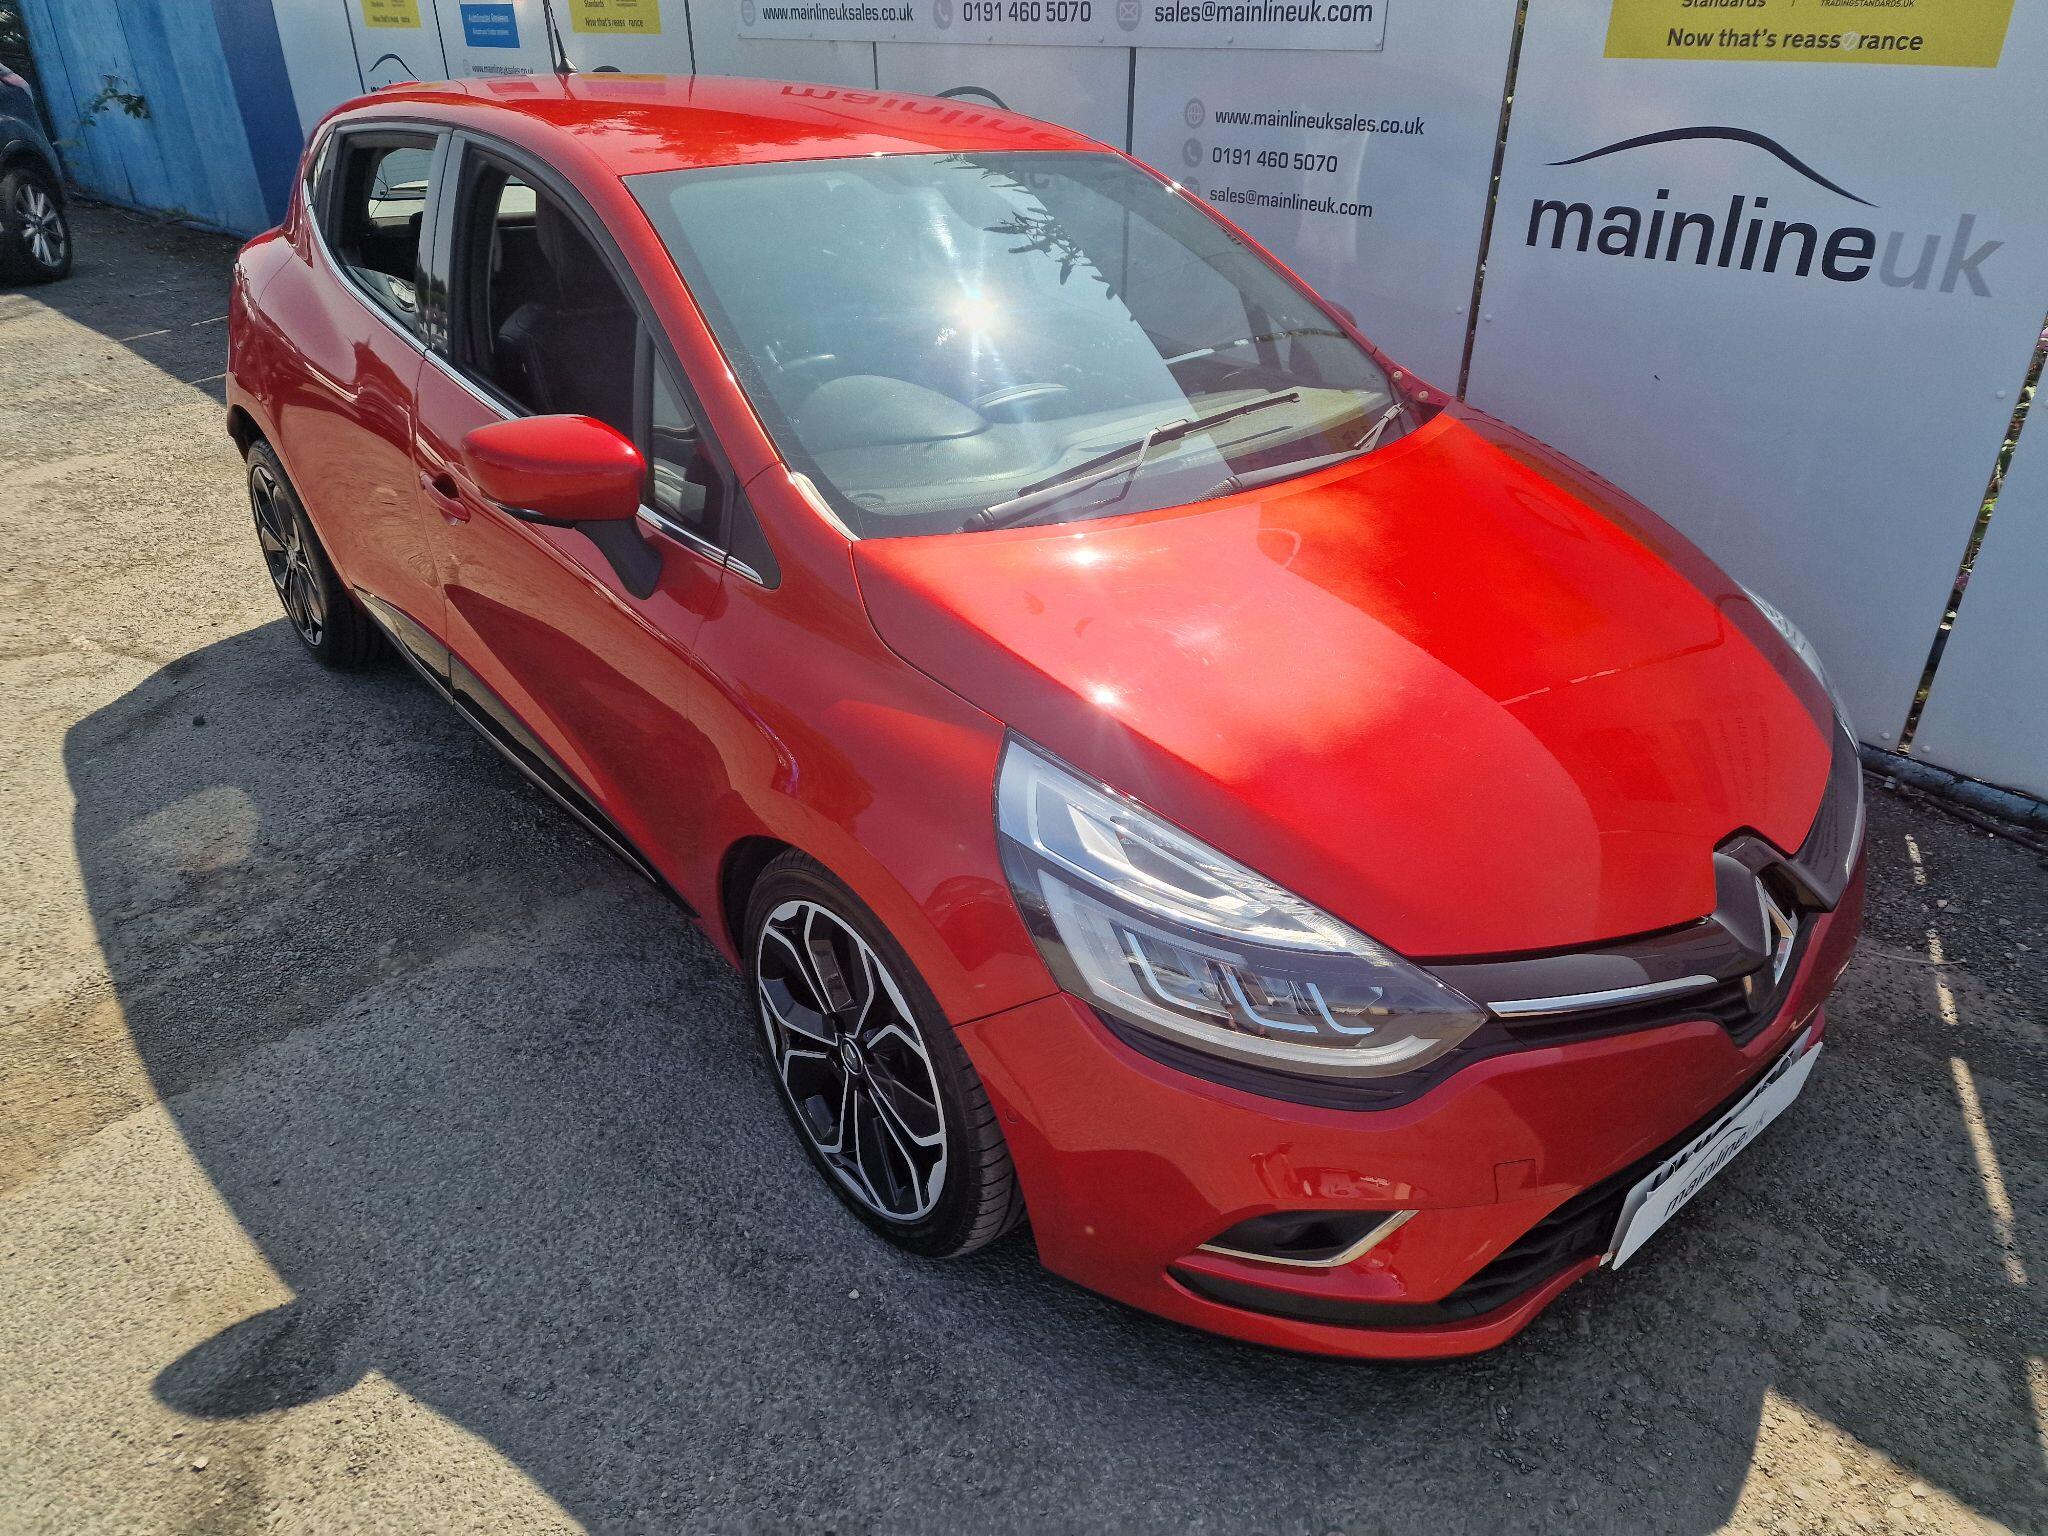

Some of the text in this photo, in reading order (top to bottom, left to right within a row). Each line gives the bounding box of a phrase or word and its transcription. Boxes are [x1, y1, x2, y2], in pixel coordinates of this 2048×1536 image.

[762, 0, 1373, 23] www.mainlineuksales.co.uk 0191 460 5070 sales@mainlineuk.com
[1667, 28, 1714, 47] Now
[1719, 28, 1777, 48] that's
[1215, 109, 1425, 135] www.mainlineuksales.co.uk
[1212, 147, 1338, 173] 0191 460 5070
[1210, 187, 1373, 218] sales@mainlineuk.com
[1526, 188, 2005, 298] mainlineuk
